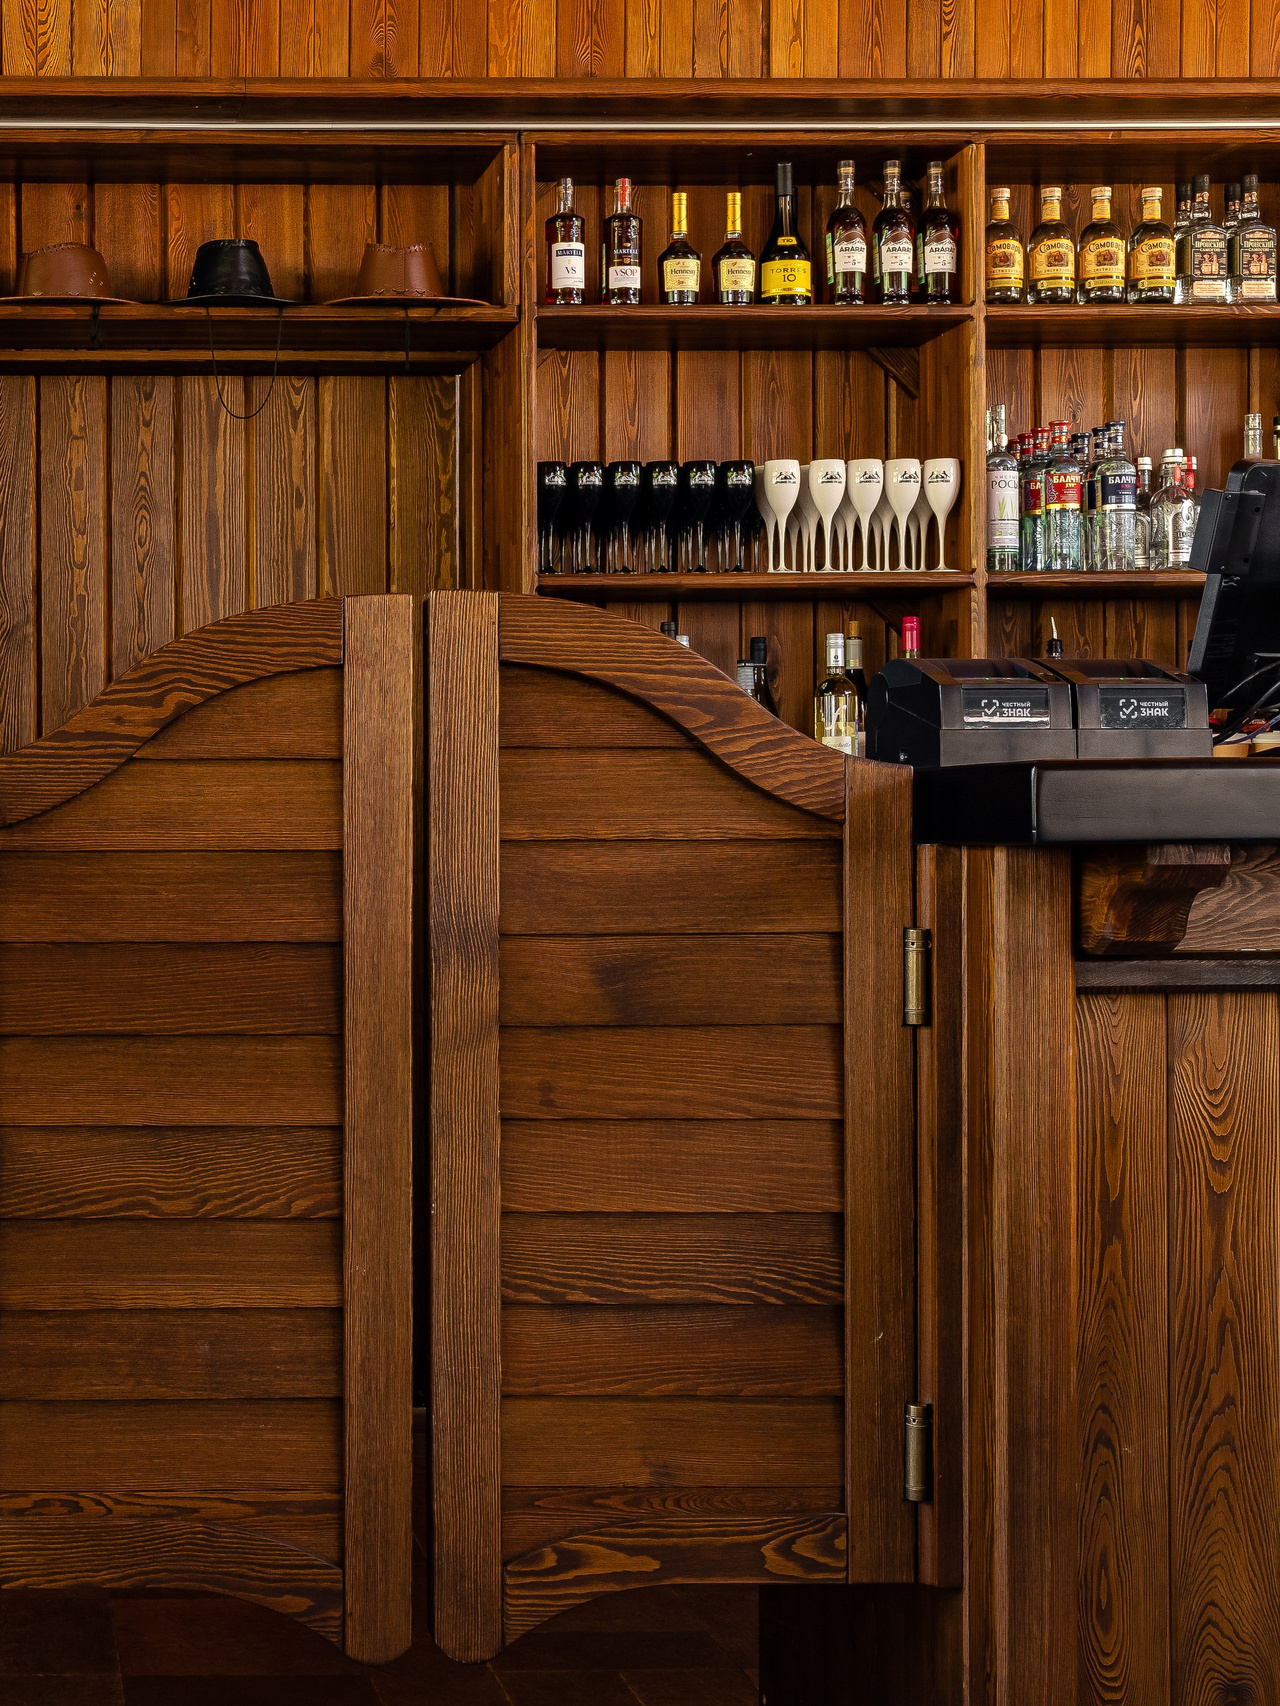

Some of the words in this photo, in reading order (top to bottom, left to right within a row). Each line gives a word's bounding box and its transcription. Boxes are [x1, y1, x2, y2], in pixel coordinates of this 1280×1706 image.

[565, 266, 577, 274] VS
[614, 268, 638, 277] VSOP
[782, 274, 797, 282] 10
[1002, 708, 1031, 717] ЗНАК
[1140, 708, 1169, 716] ЗНАК
